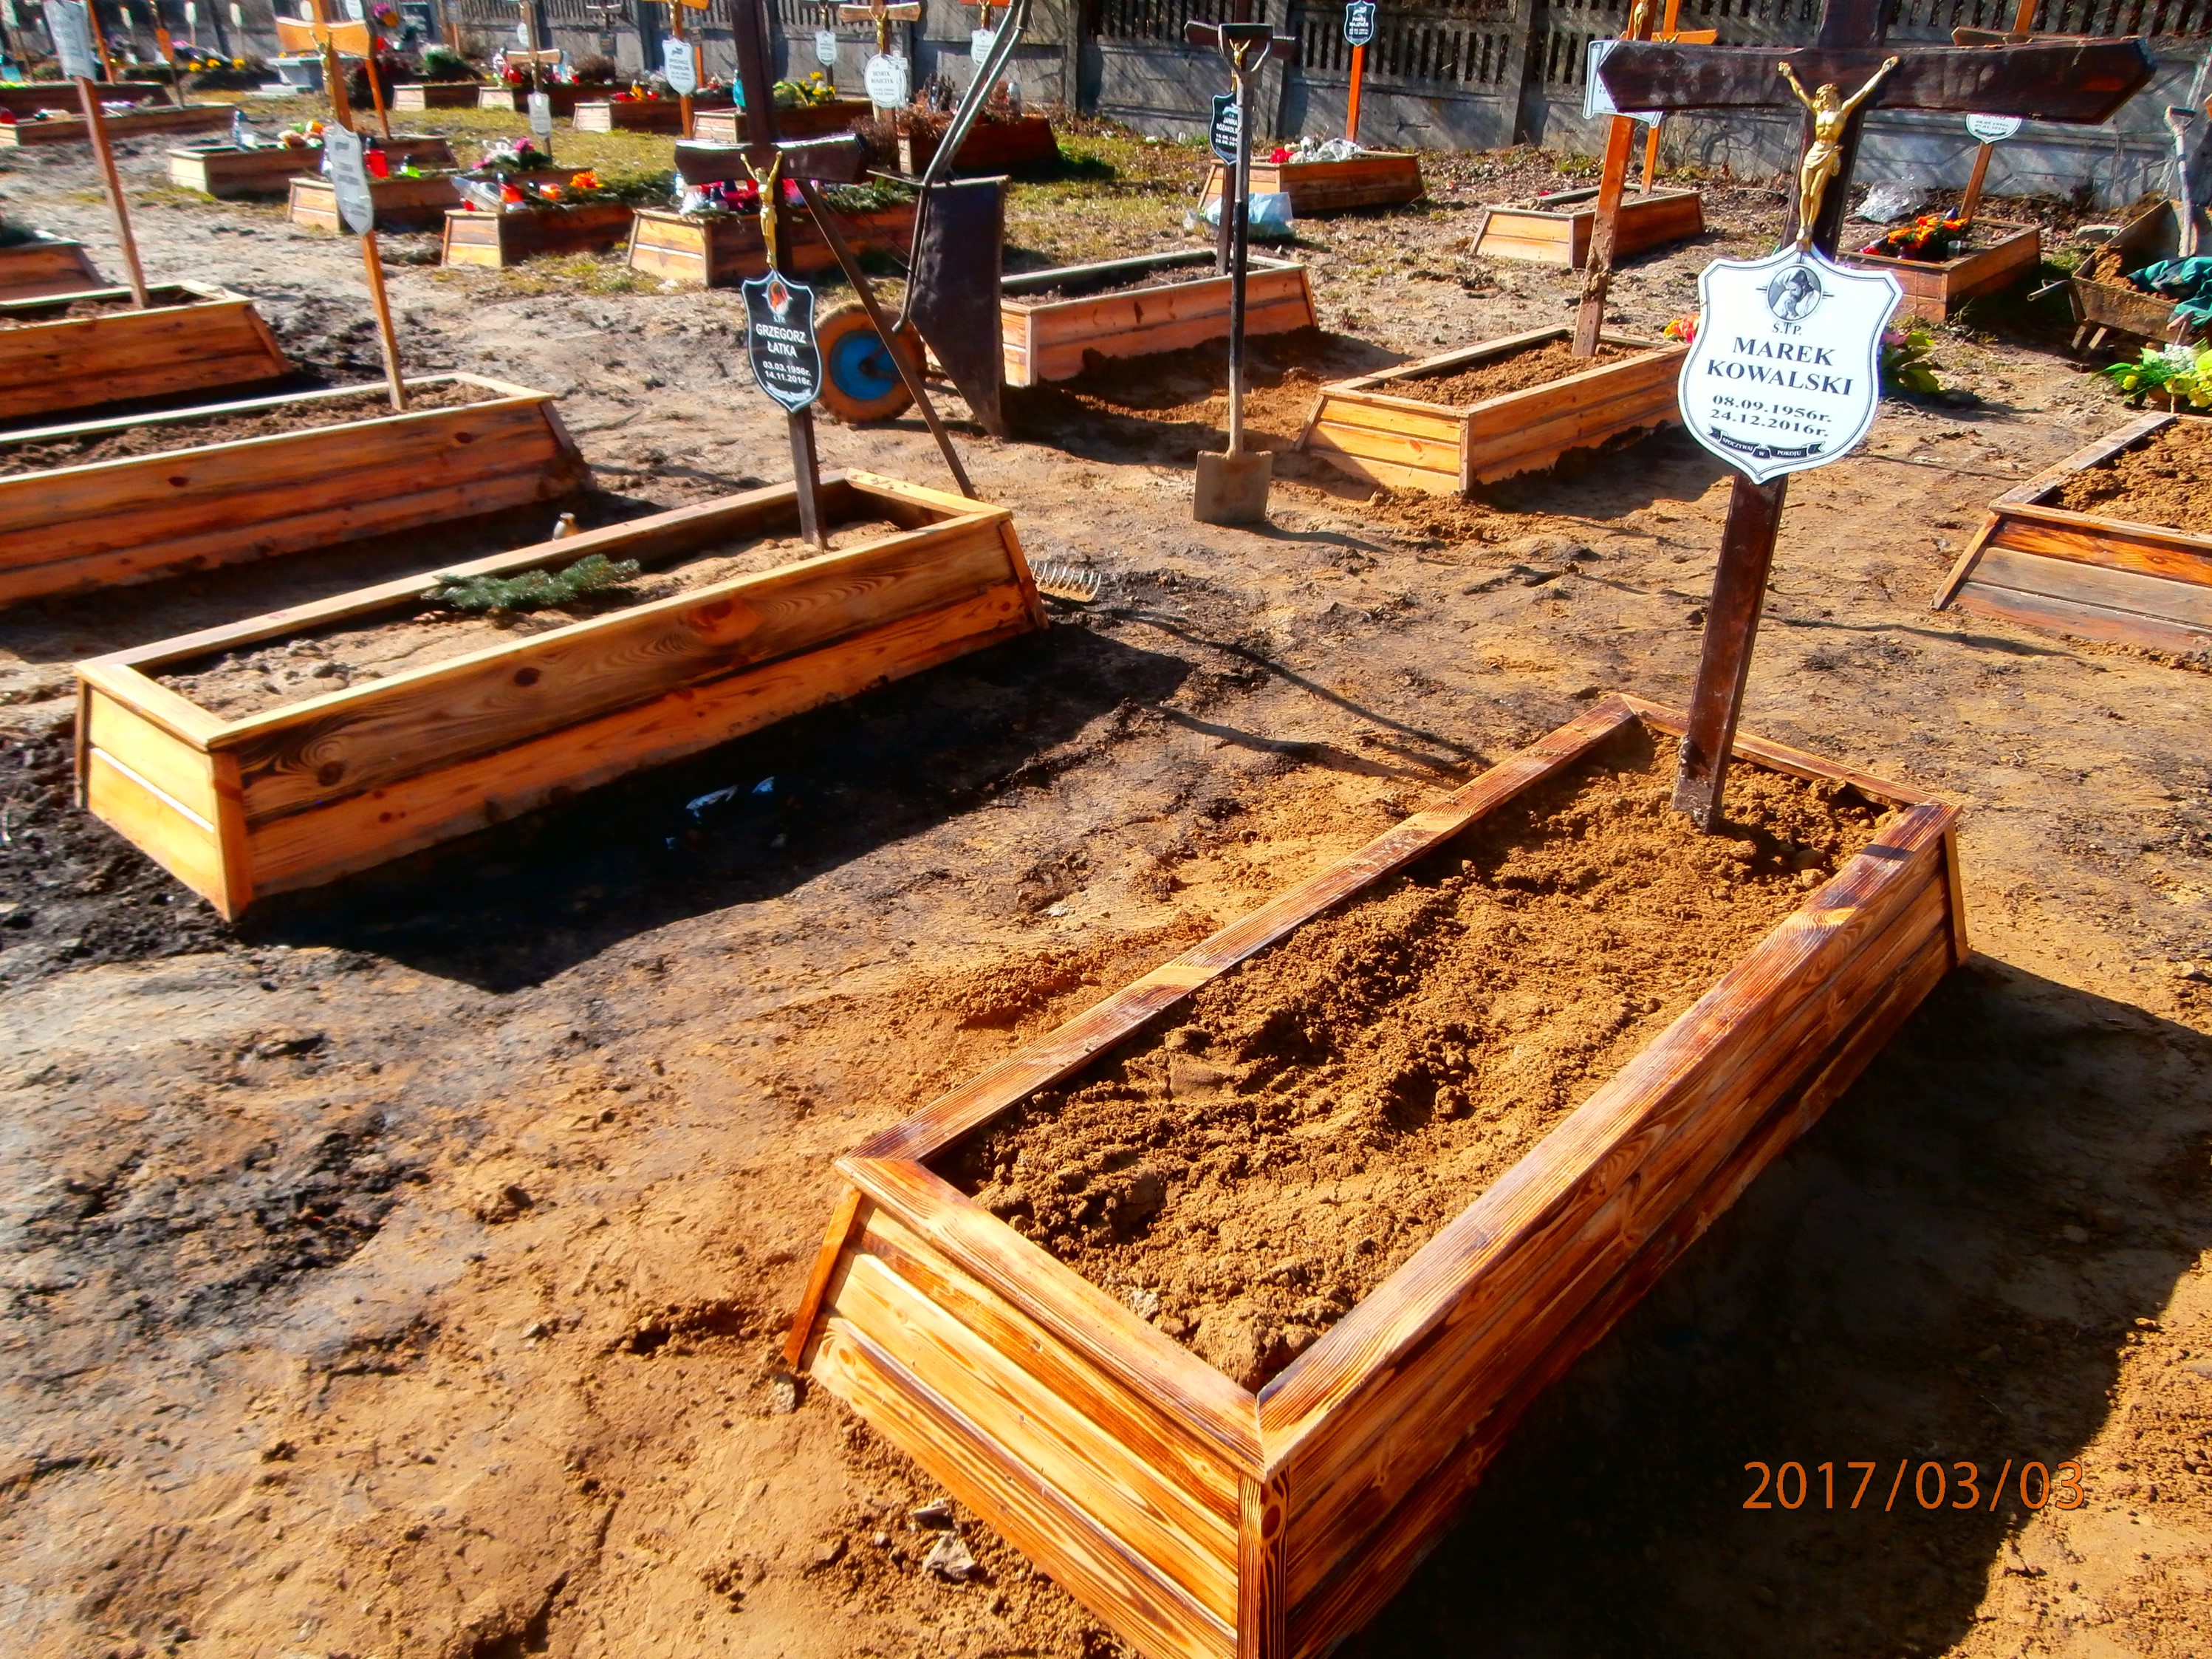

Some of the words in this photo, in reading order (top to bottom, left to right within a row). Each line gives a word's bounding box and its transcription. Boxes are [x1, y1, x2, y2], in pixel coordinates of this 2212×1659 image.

[756, 323, 807, 345] GRZEGORZ
[767, 340, 798, 358] ŁATKA
[1732, 336, 1836, 366] MAREK
[1705, 359, 1855, 396] KOWALSKI
[1710, 408, 1829, 437] 24.12.2016r.
[1712, 394, 1832, 423] 08.09.1956r.
